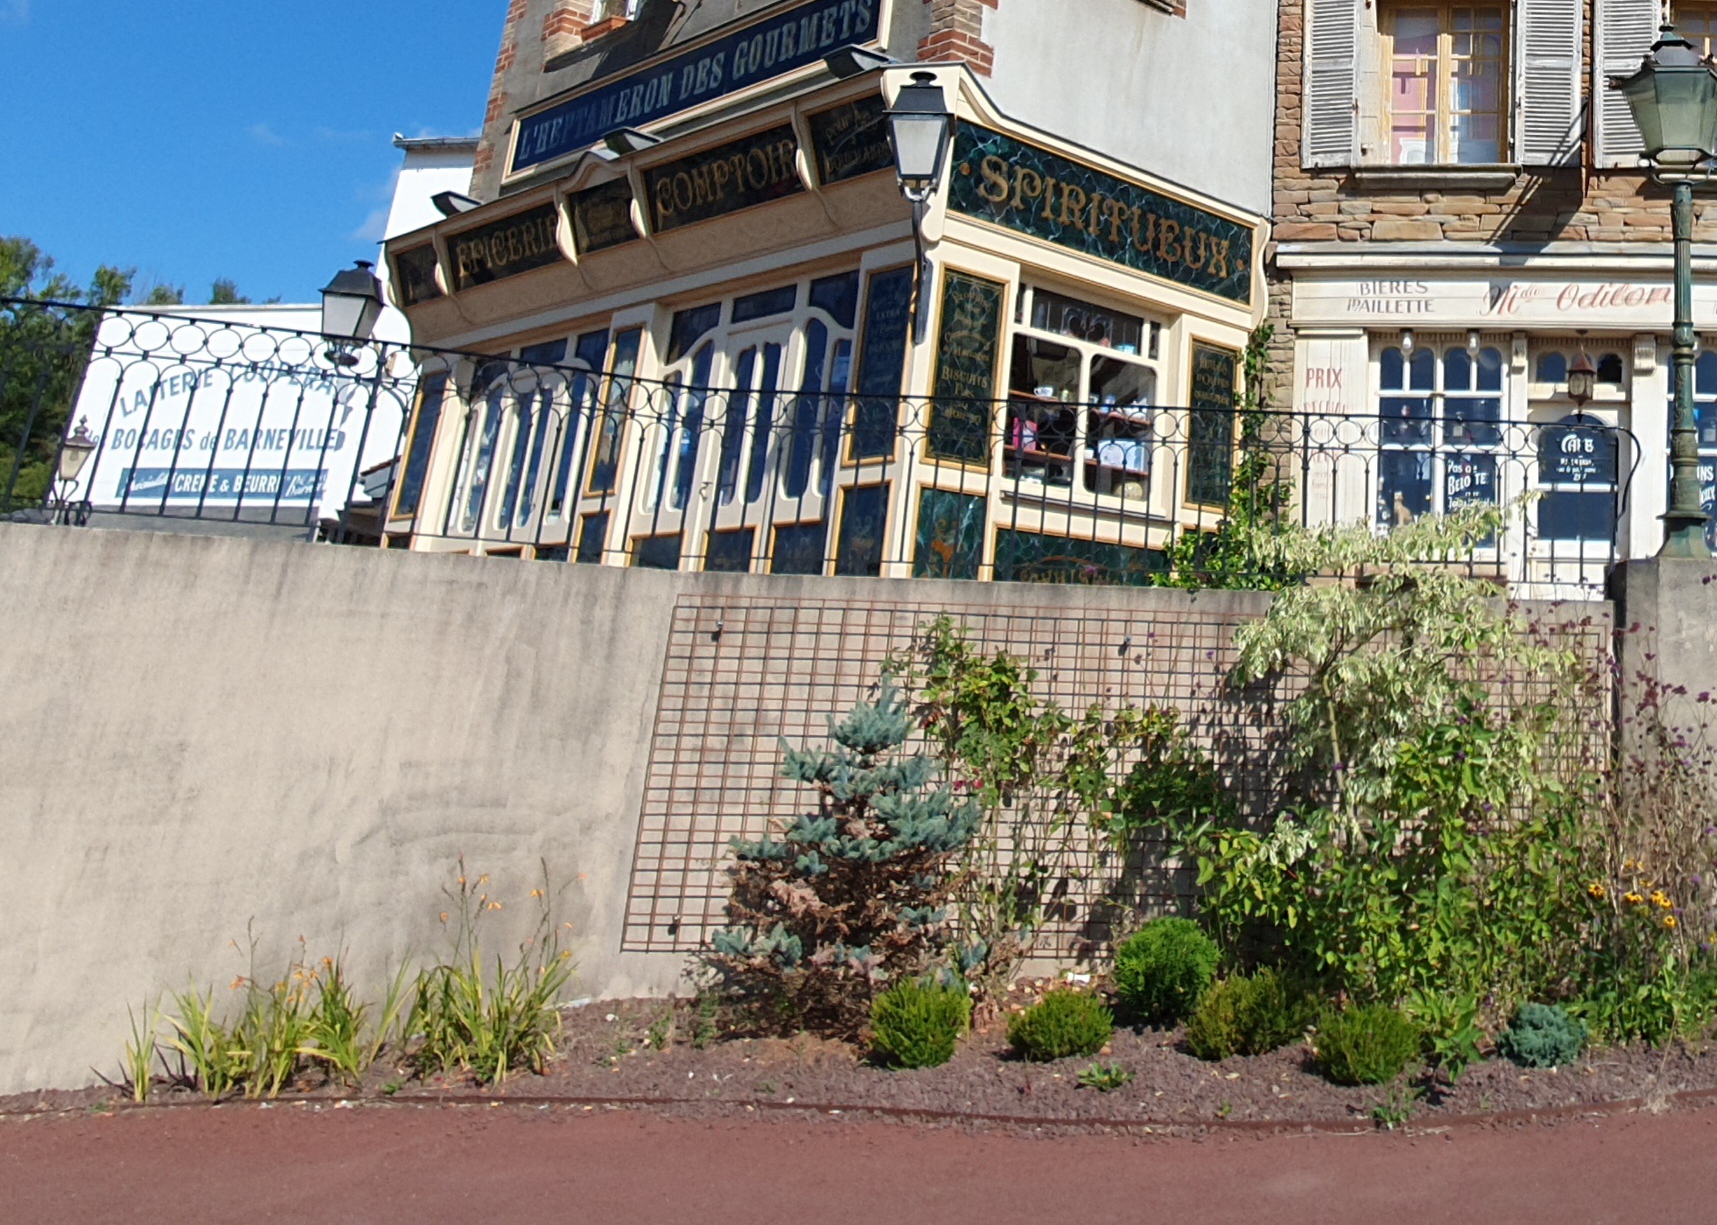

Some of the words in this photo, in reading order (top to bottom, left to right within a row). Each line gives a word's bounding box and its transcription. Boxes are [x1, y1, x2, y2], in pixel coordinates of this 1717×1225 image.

[679, 50, 726, 102] DES
[656, 138, 797, 217] COMPTOIR
[977, 155, 1230, 279] SPIRITUEUX
[1306, 367, 1343, 389] PRIX
[111, 428, 196, 451] BOAGS
[220, 478, 230, 491] &
[232, 473, 282, 494] BEURR
